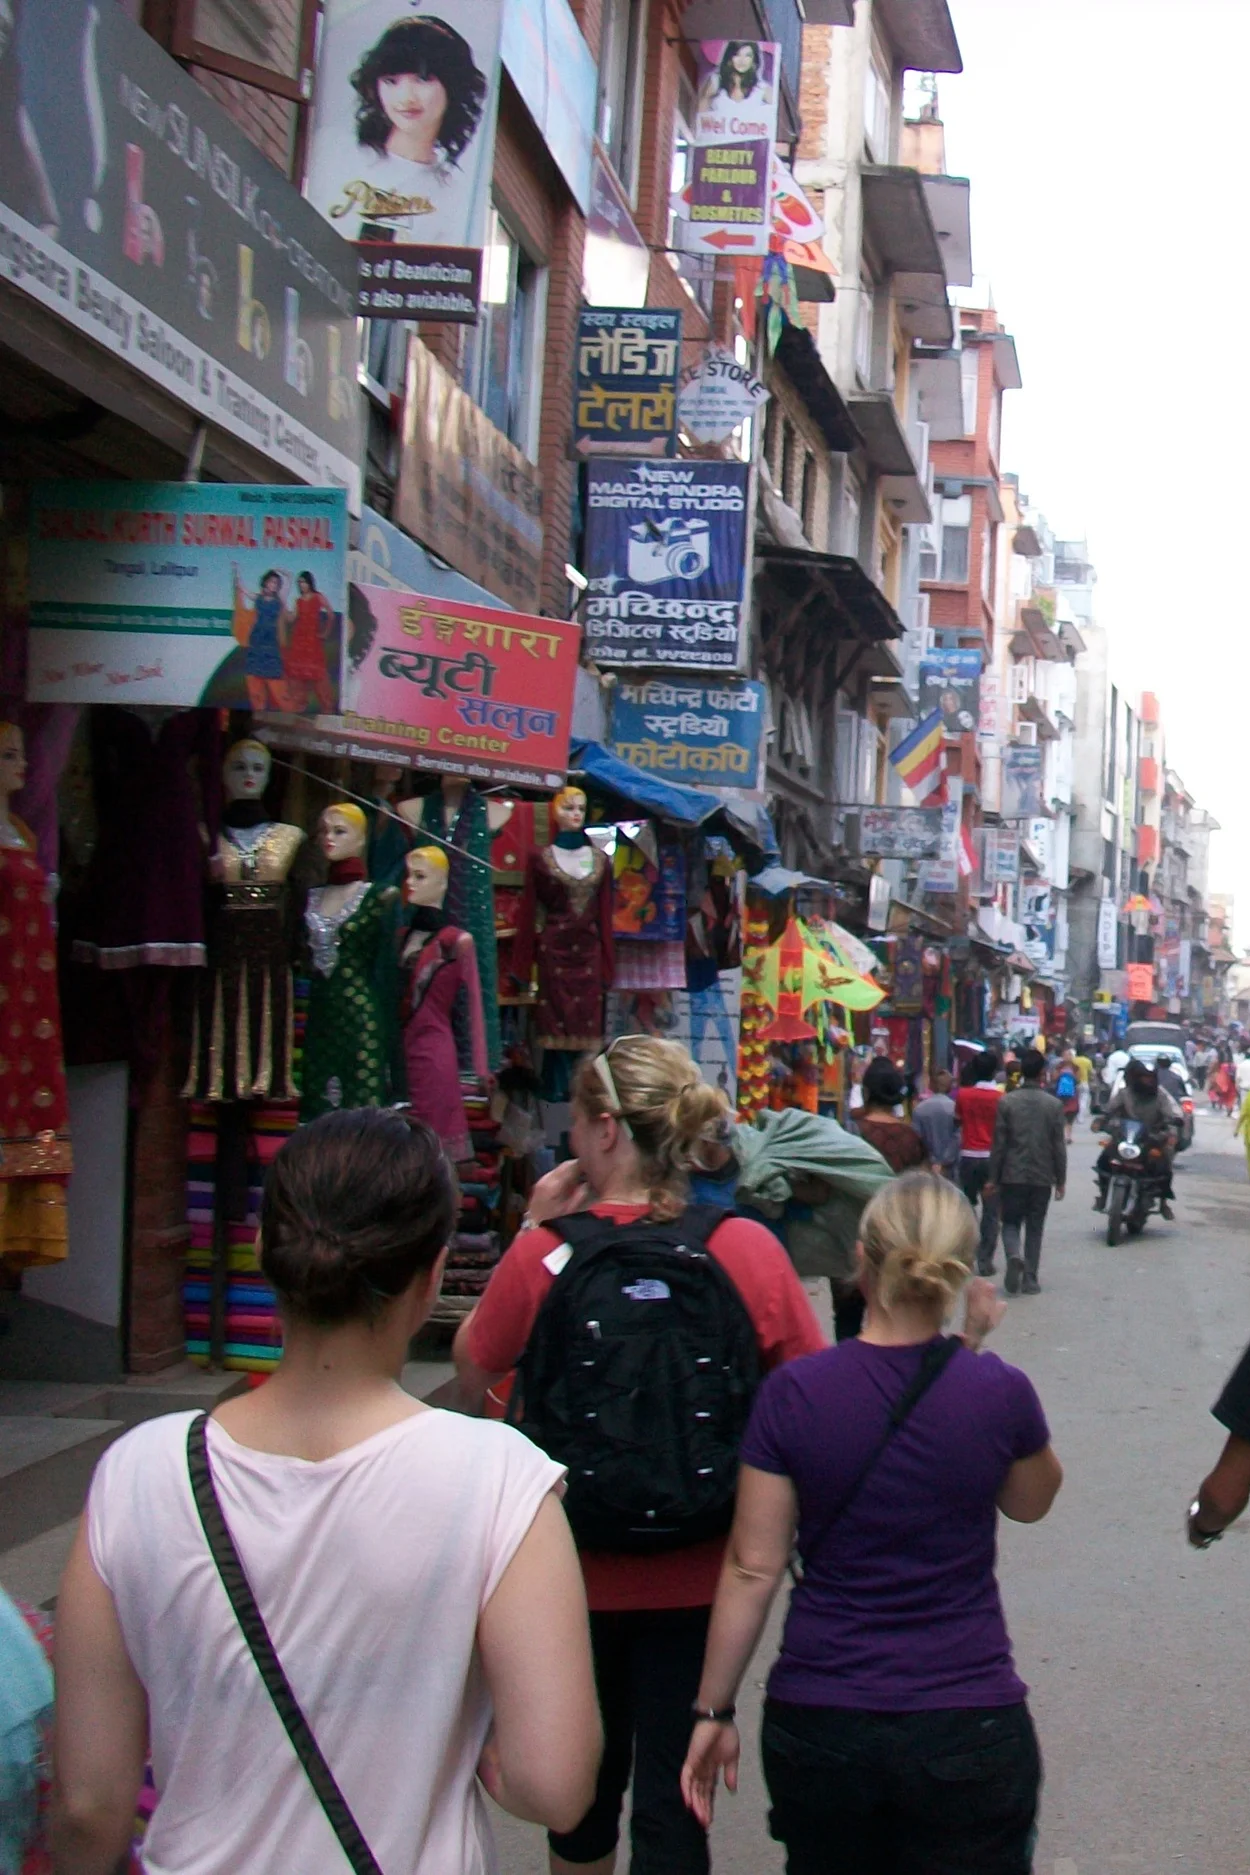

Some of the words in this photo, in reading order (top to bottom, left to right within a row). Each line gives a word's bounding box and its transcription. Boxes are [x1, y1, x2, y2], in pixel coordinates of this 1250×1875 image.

[707, 361, 768, 398] STORE
[640, 468, 695, 484] NEW
[588, 482, 743, 498] MACHHINDRA
[588, 496, 665, 509] DIGITAL
[668, 498, 744, 511] STUDIO
[342, 710, 430, 745] Training
[436, 727, 511, 754] Center
